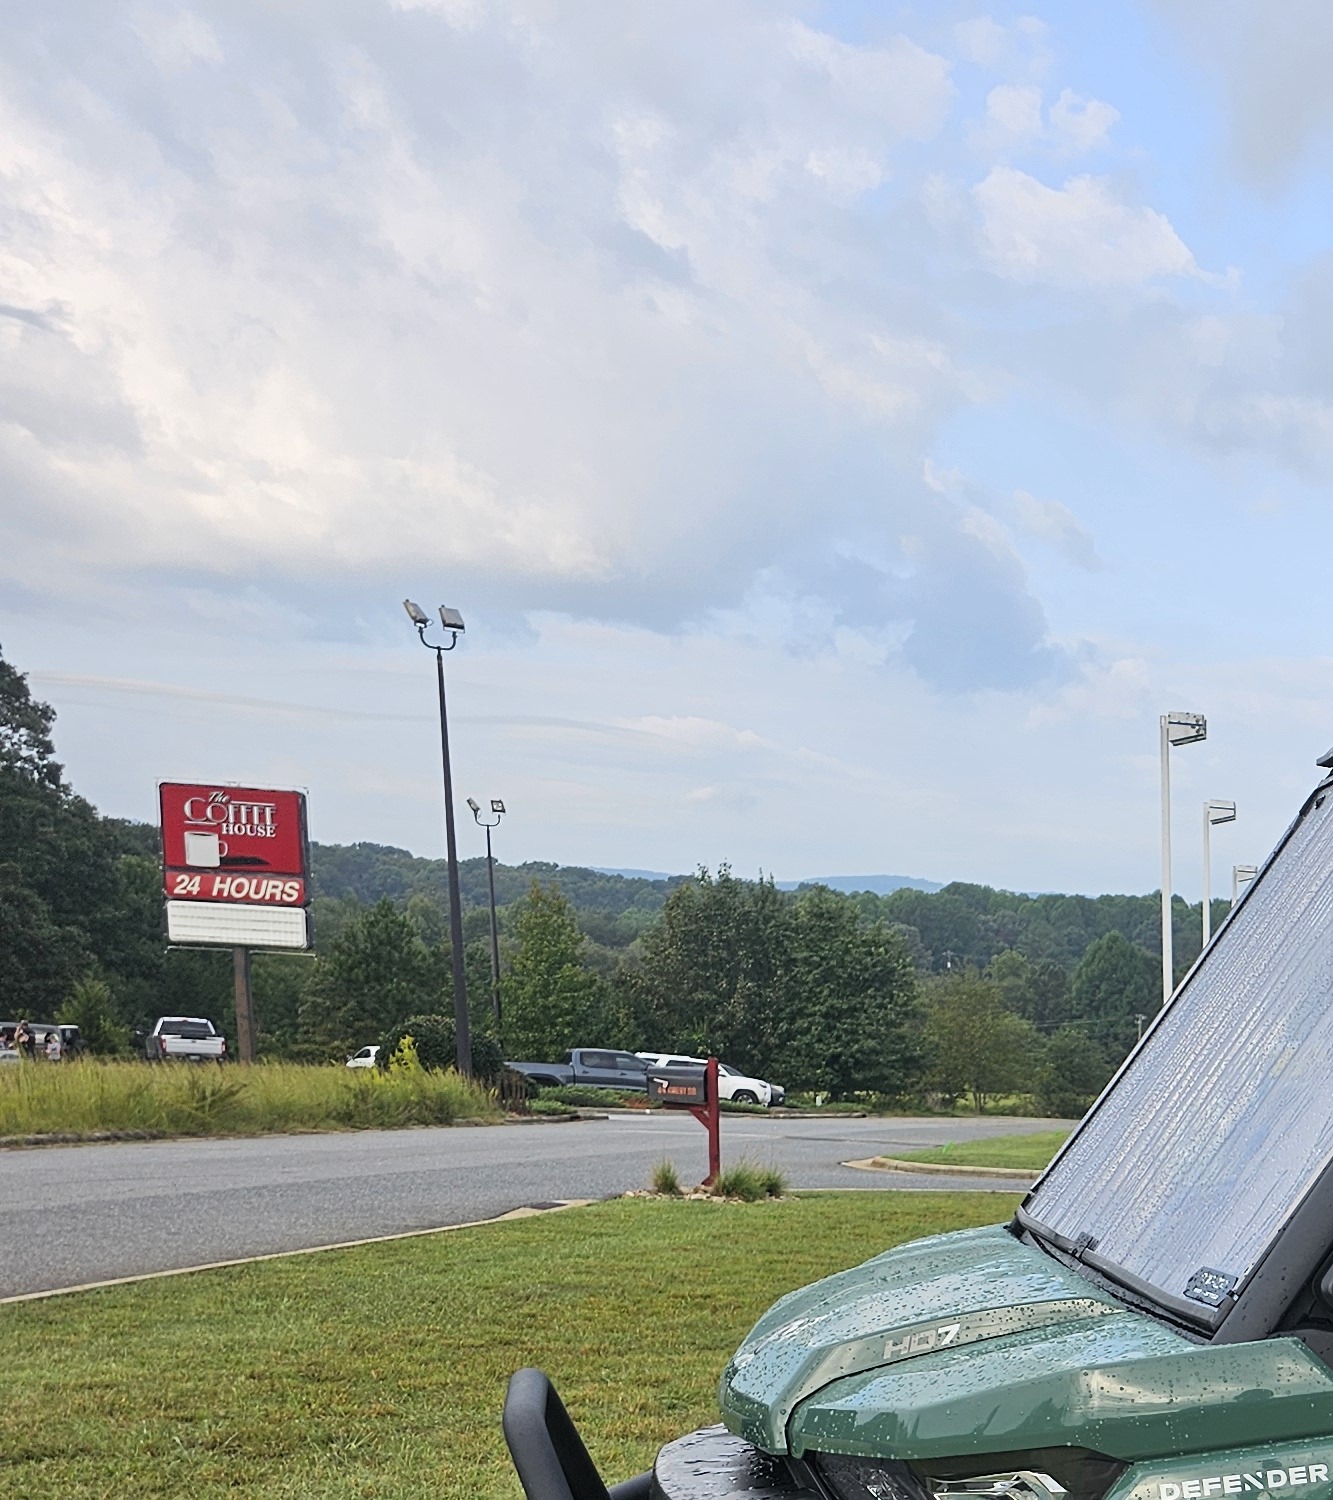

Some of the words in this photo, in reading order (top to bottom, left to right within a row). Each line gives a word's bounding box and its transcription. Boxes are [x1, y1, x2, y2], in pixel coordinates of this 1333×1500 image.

[208, 791, 230, 803] The
[221, 823, 277, 838] HOUSE
[173, 874, 202, 895] 24
[212, 876, 301, 902] HOURS
[883, 1323, 961, 1360] HD7
[1160, 1463, 1329, 1500] DEFENDER
